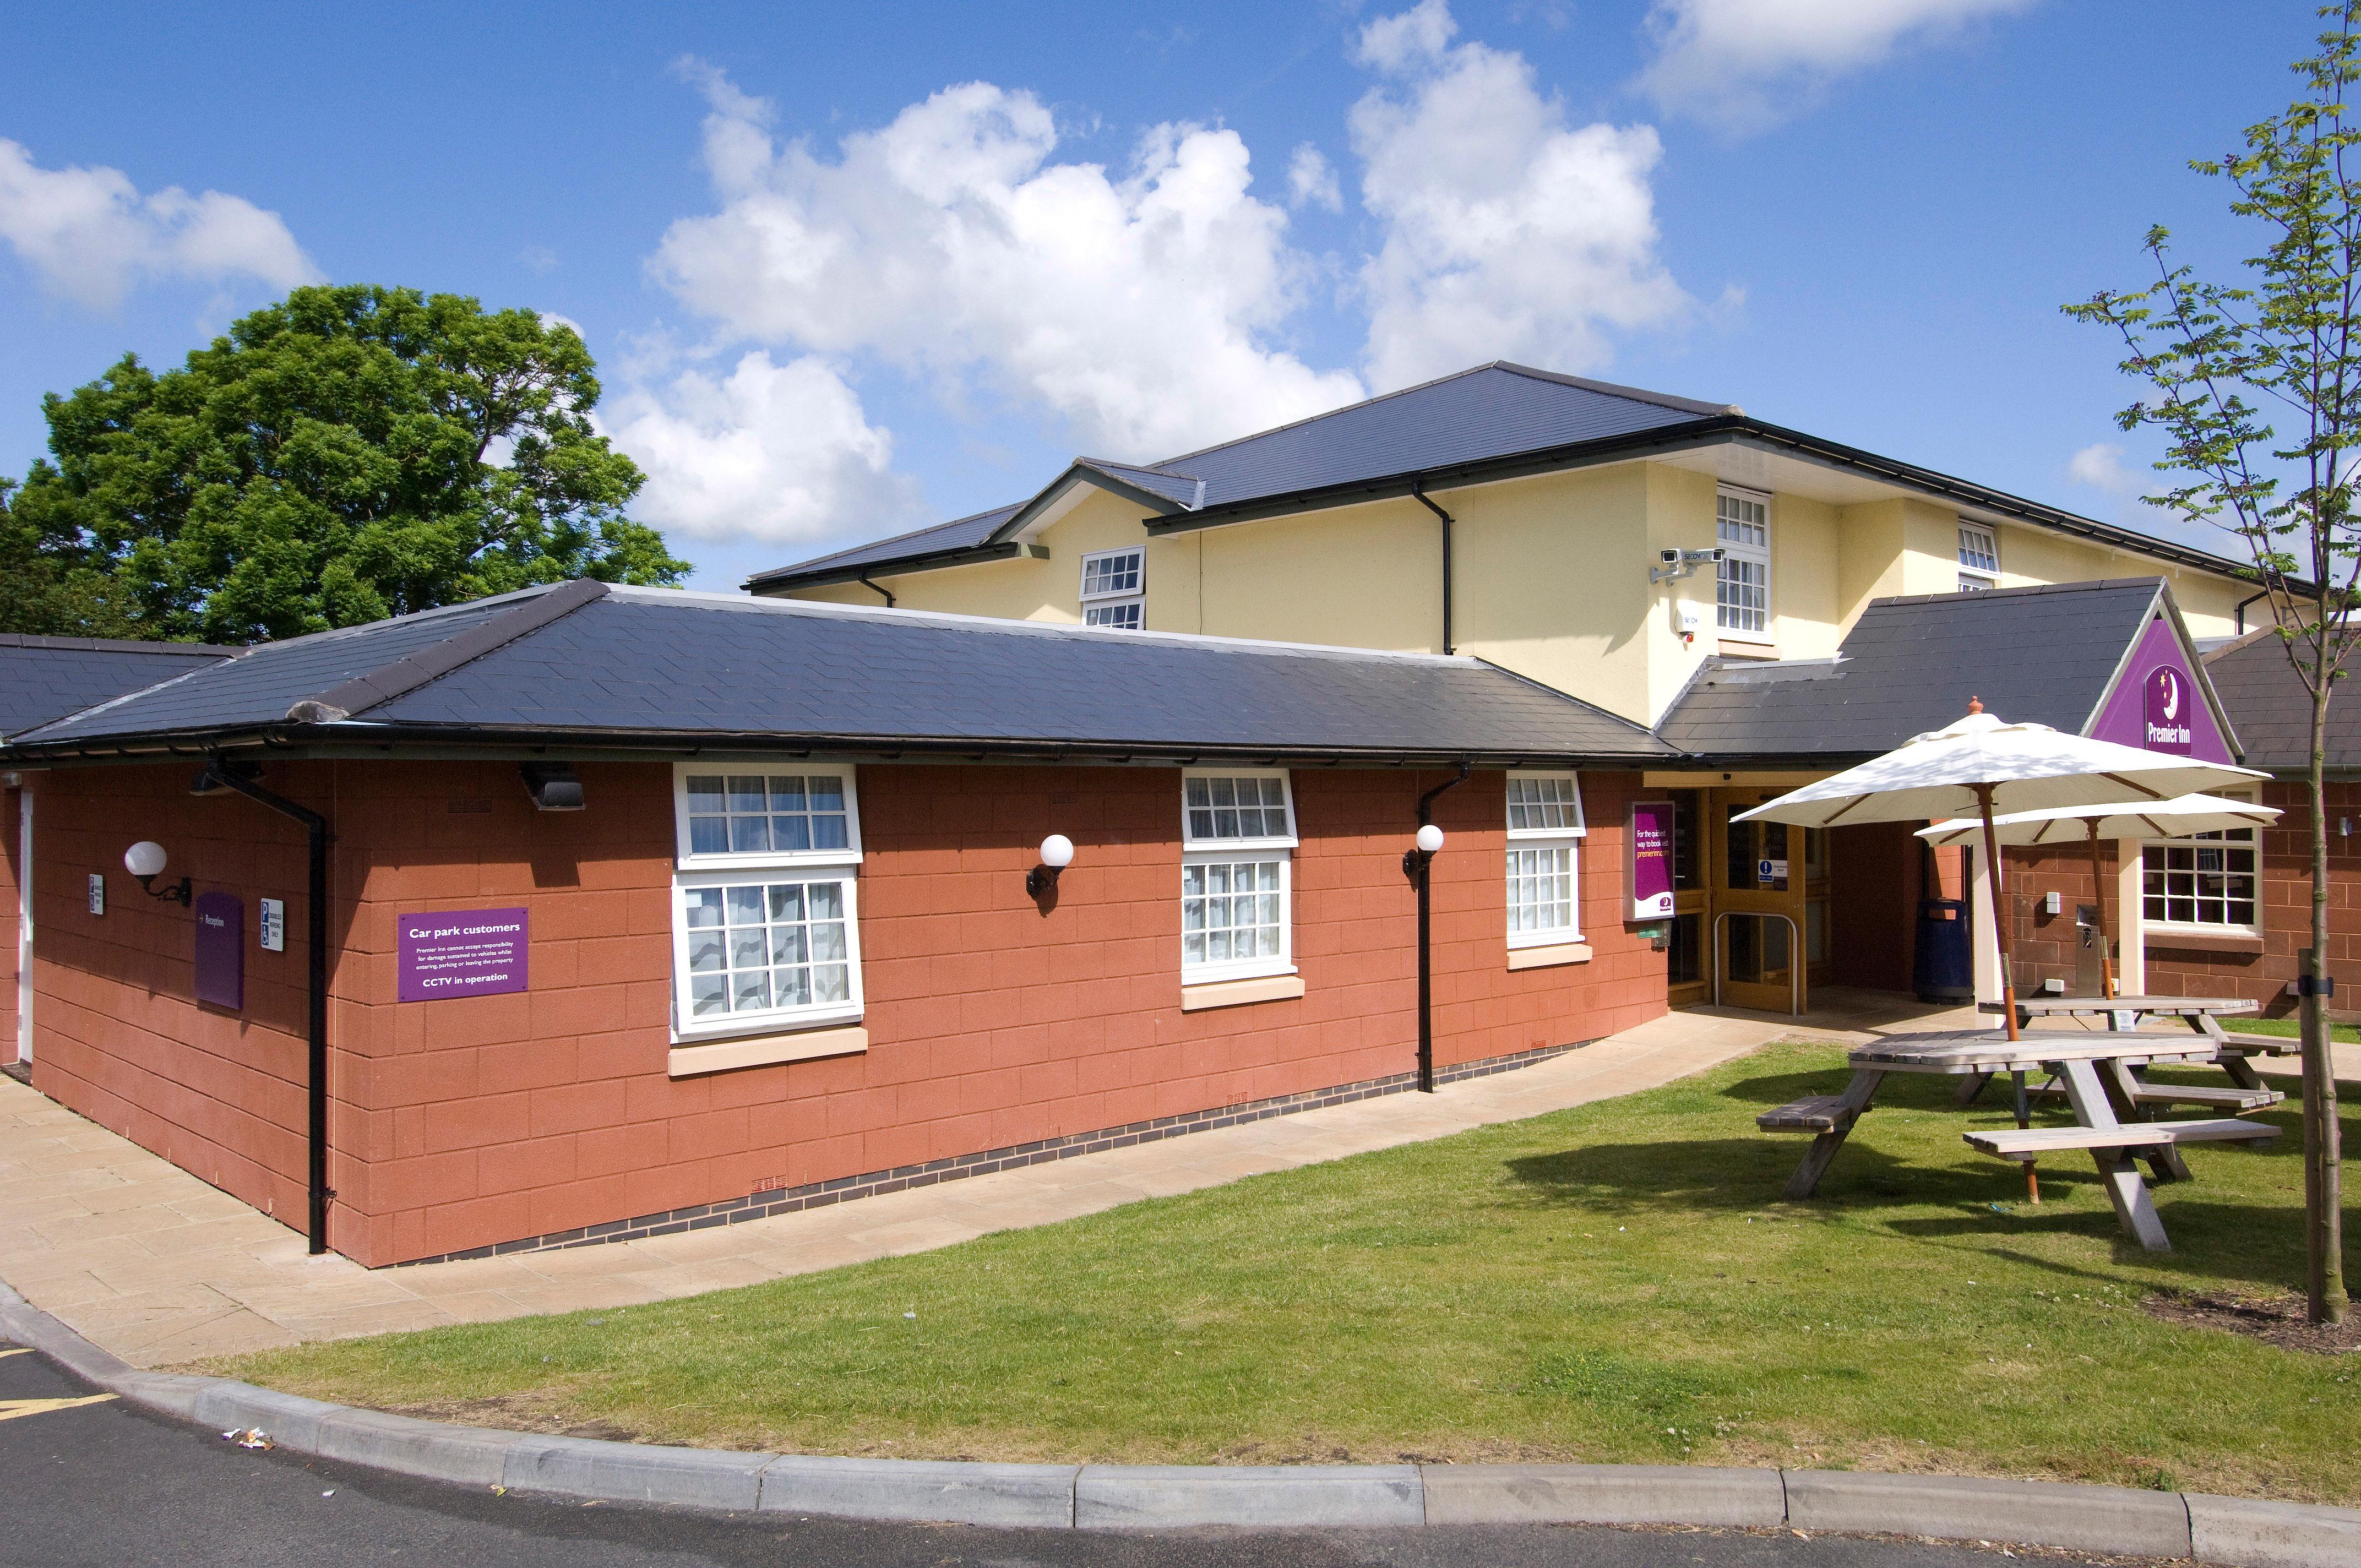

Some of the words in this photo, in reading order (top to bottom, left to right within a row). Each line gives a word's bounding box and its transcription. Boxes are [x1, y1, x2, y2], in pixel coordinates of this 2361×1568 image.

[2148, 722, 2178, 743] Premier
[2178, 723, 2190, 743] Inn
[263, 902, 268, 921] P
[205, 914, 224, 928] Reception
[409, 928, 431, 938] Car
[434, 925, 460, 939] park
[463, 924, 520, 934] customers
[482, 941, 514, 950] responsibility
[422, 977, 452, 987] CCTV
[454, 976, 463, 984] in
[465, 973, 508, 985] operation
